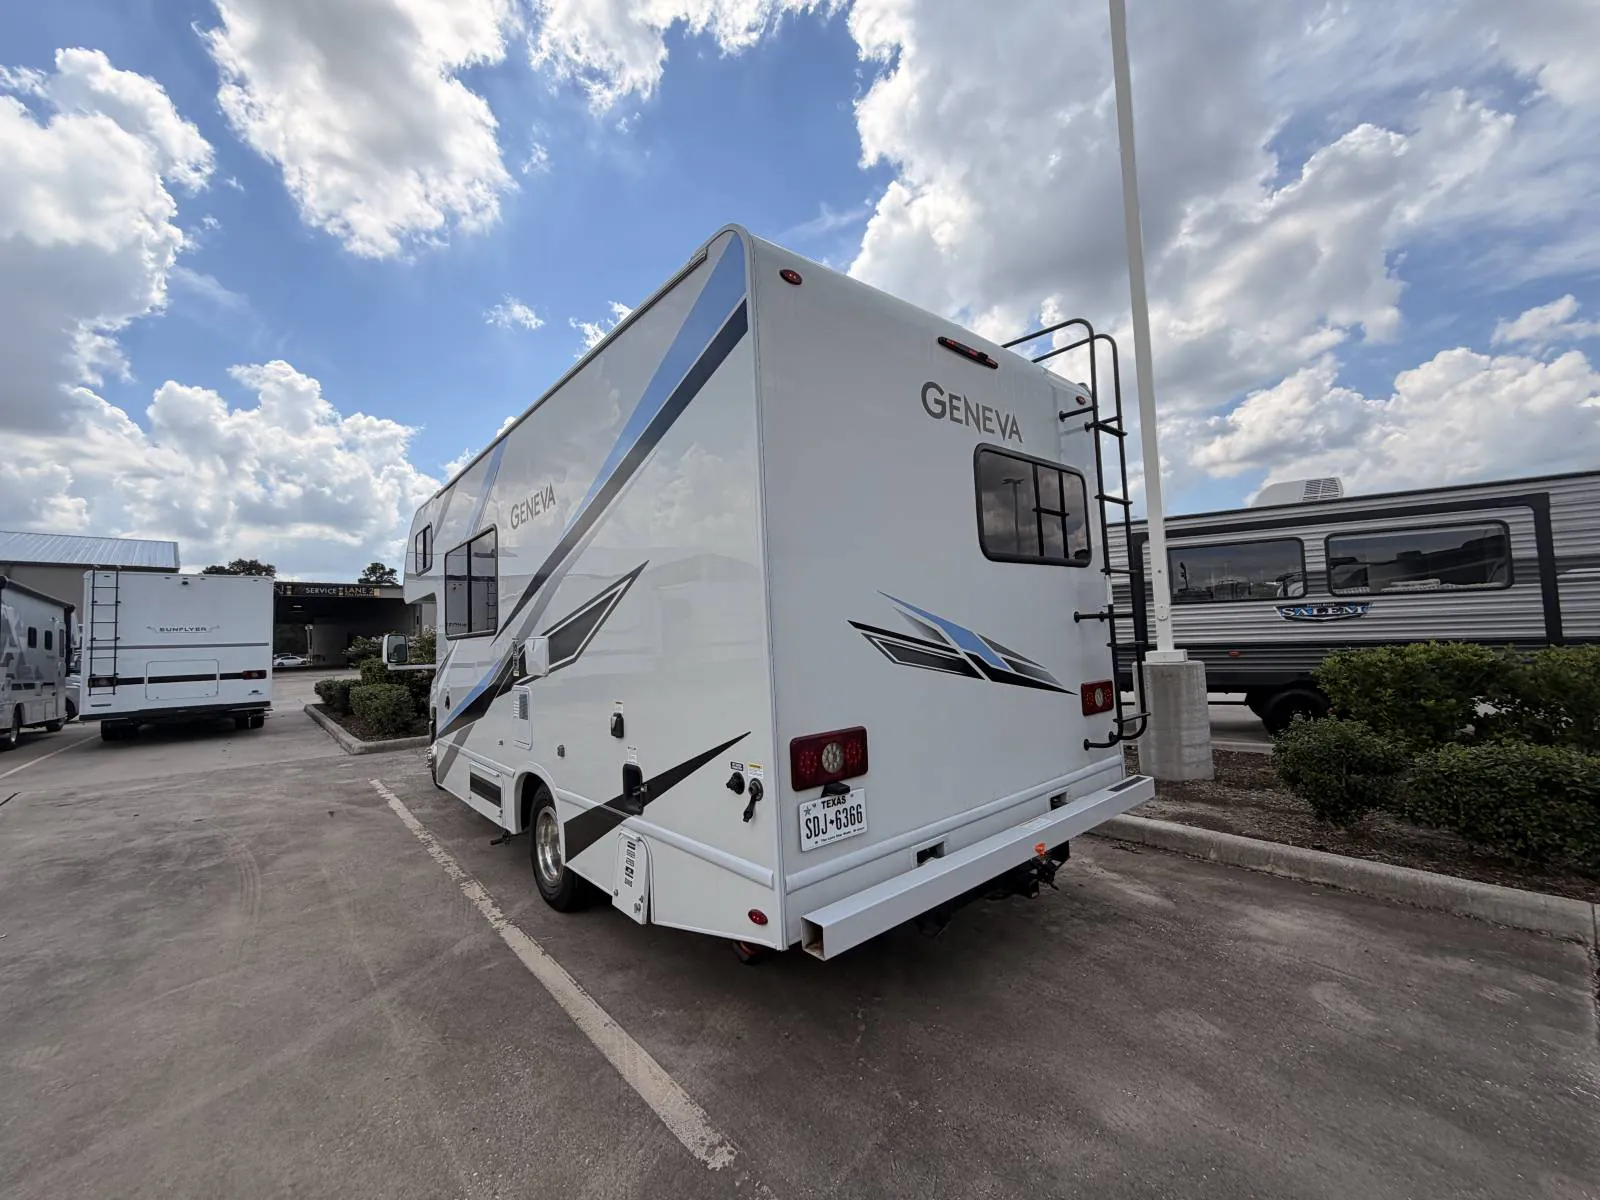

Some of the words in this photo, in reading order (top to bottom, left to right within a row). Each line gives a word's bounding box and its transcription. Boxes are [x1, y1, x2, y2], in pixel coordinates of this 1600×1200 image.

[921, 381, 1023, 443] GENEVA
[510, 481, 556, 530] GENEVA
[305, 587, 337, 595] SERVICE
[344, 586, 366, 594] LANE
[1282, 605, 1368, 616] SALEM
[821, 795, 847, 810] TEXAS
